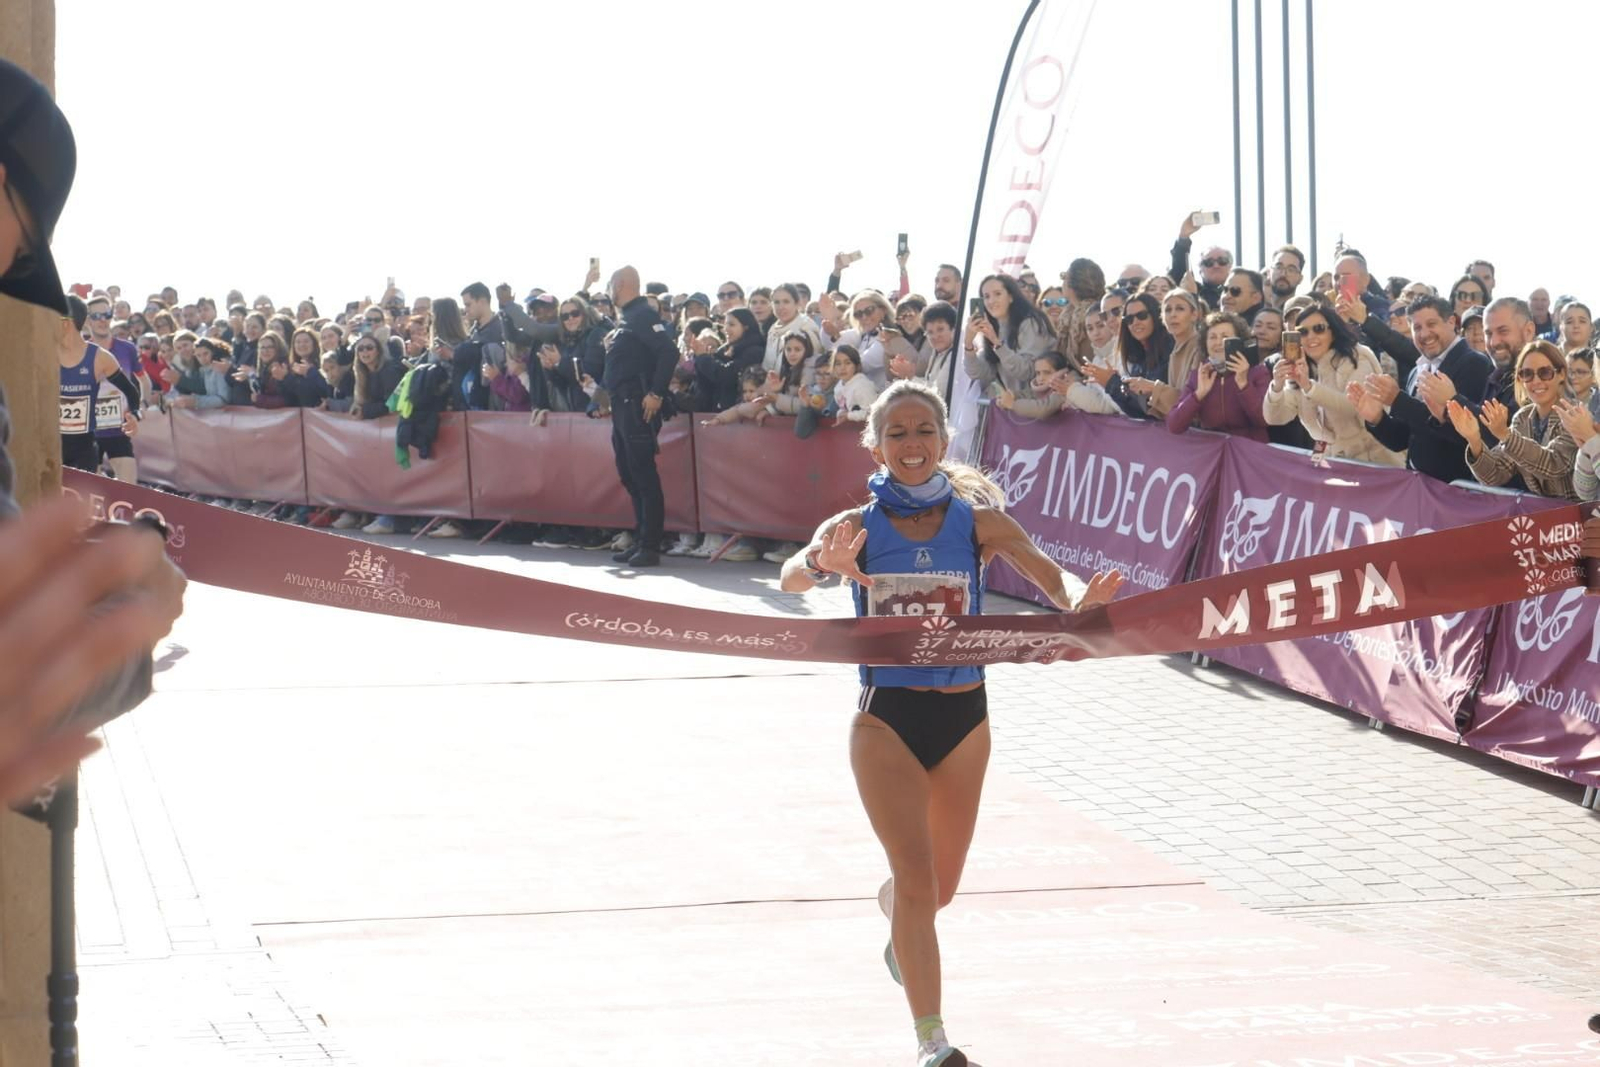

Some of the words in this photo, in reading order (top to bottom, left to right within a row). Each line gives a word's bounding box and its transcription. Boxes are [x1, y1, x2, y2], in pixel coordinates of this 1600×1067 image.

[1041, 446, 1196, 549] IMDECO
[1031, 533, 1081, 567] Municipal
[1080, 547, 1094, 568] de
[1093, 549, 1131, 581] Deportes
[1513, 548, 1537, 568] 37
[284, 572, 369, 597] AYUNTAMIENTO
[1197, 562, 1400, 640] META
[915, 638, 946, 649] 37
[957, 629, 1024, 639] MEDIA
